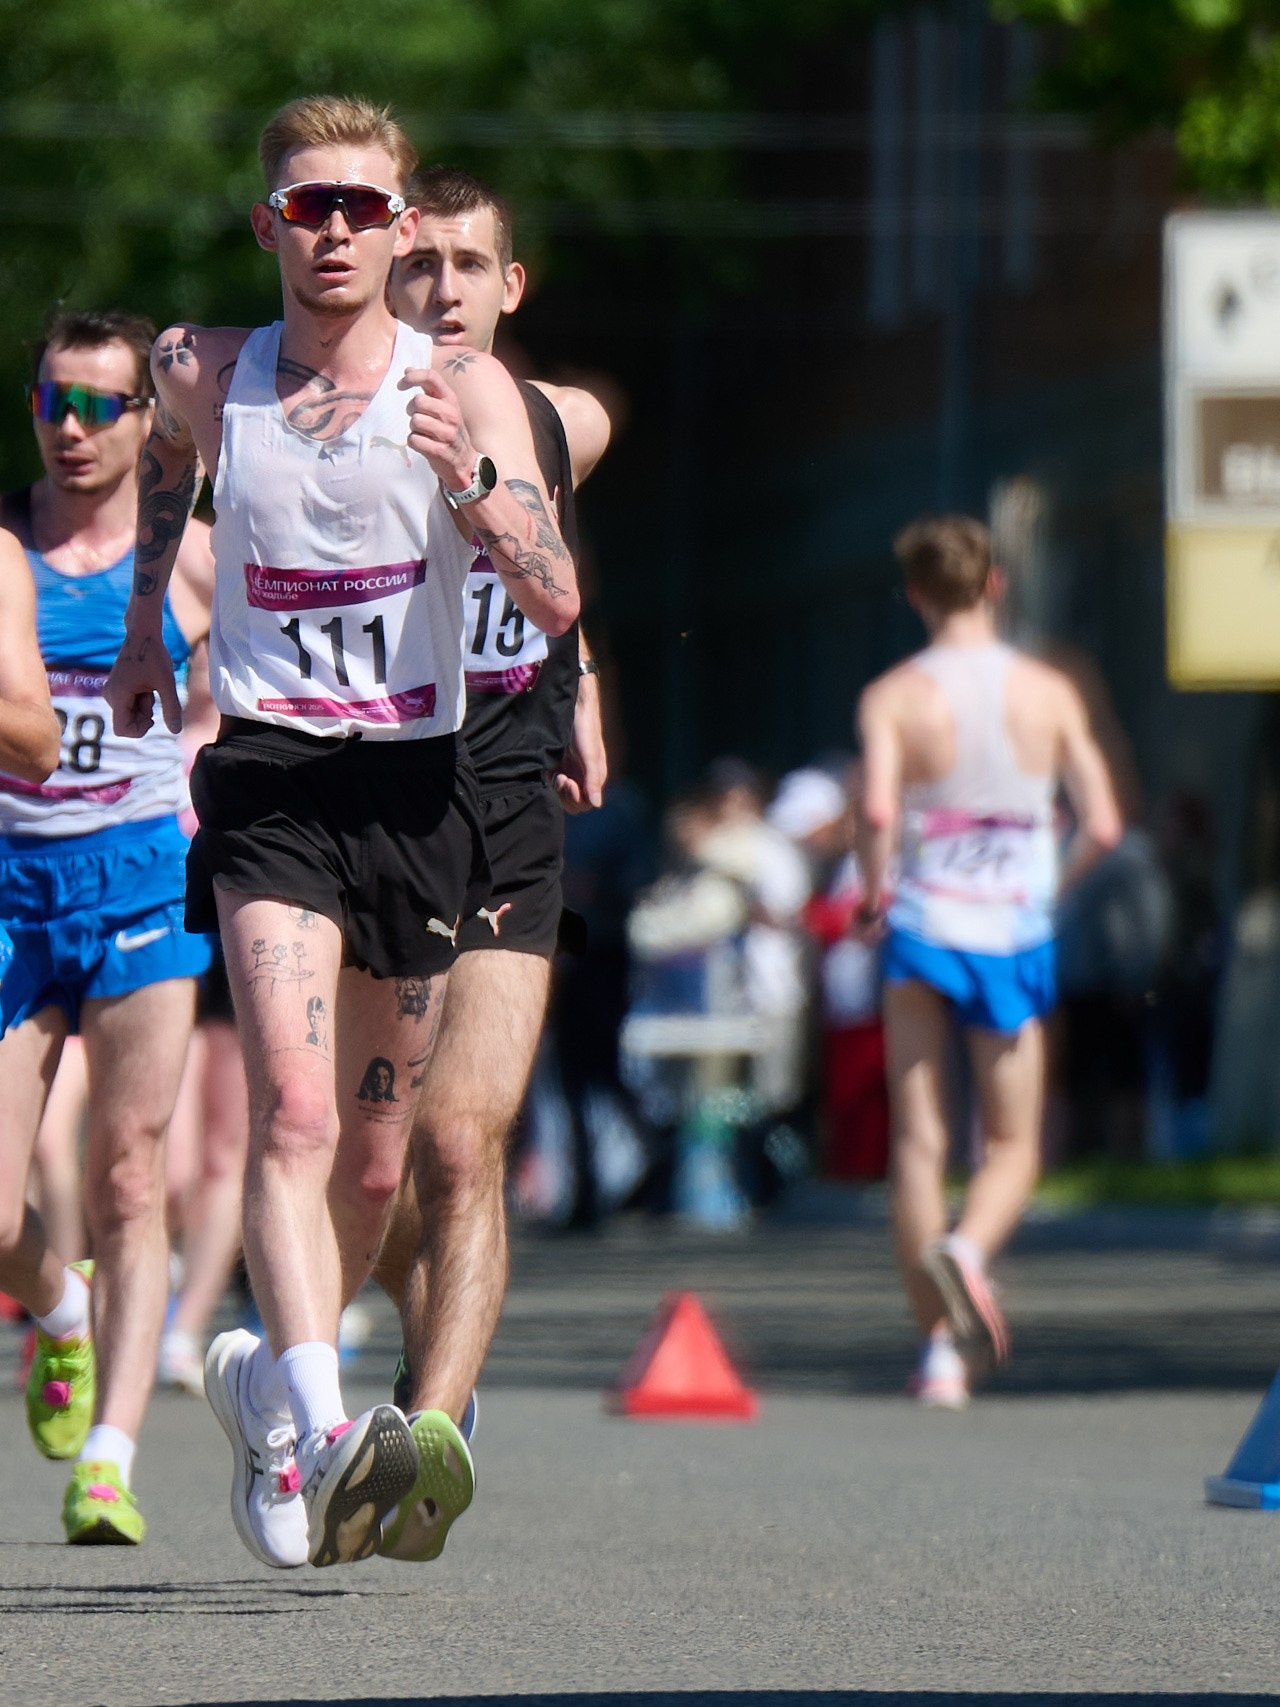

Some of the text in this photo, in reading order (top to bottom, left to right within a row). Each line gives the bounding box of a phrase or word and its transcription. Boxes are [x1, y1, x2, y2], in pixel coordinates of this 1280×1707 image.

[253, 572, 408, 592] ЧЕМПИОНАТ РОССИИ
[279, 614, 387, 686] 111
